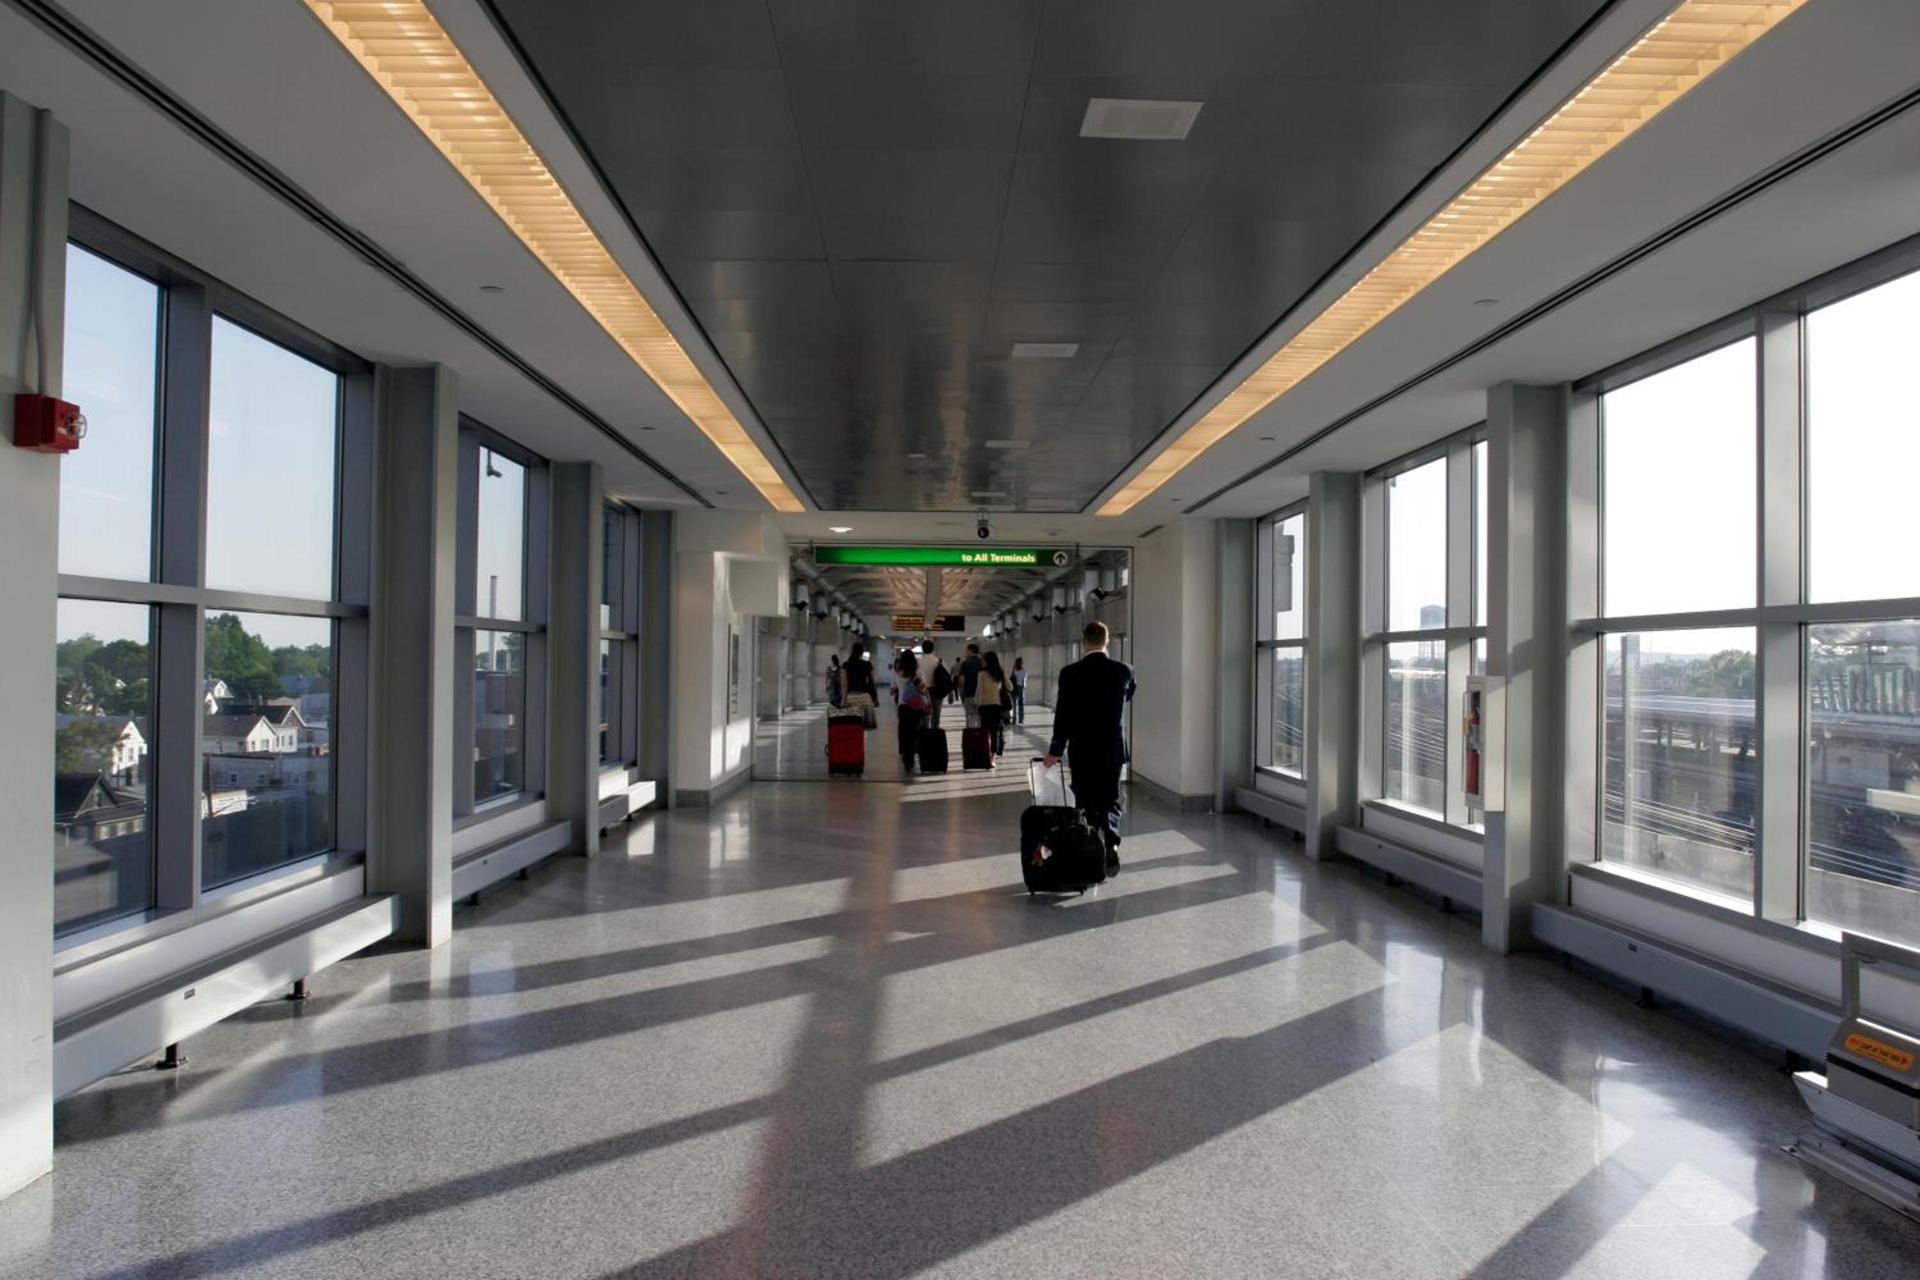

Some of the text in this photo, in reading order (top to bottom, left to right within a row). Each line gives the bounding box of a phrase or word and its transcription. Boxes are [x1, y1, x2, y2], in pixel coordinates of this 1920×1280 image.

[962, 553, 1036, 563] to All Terminals
